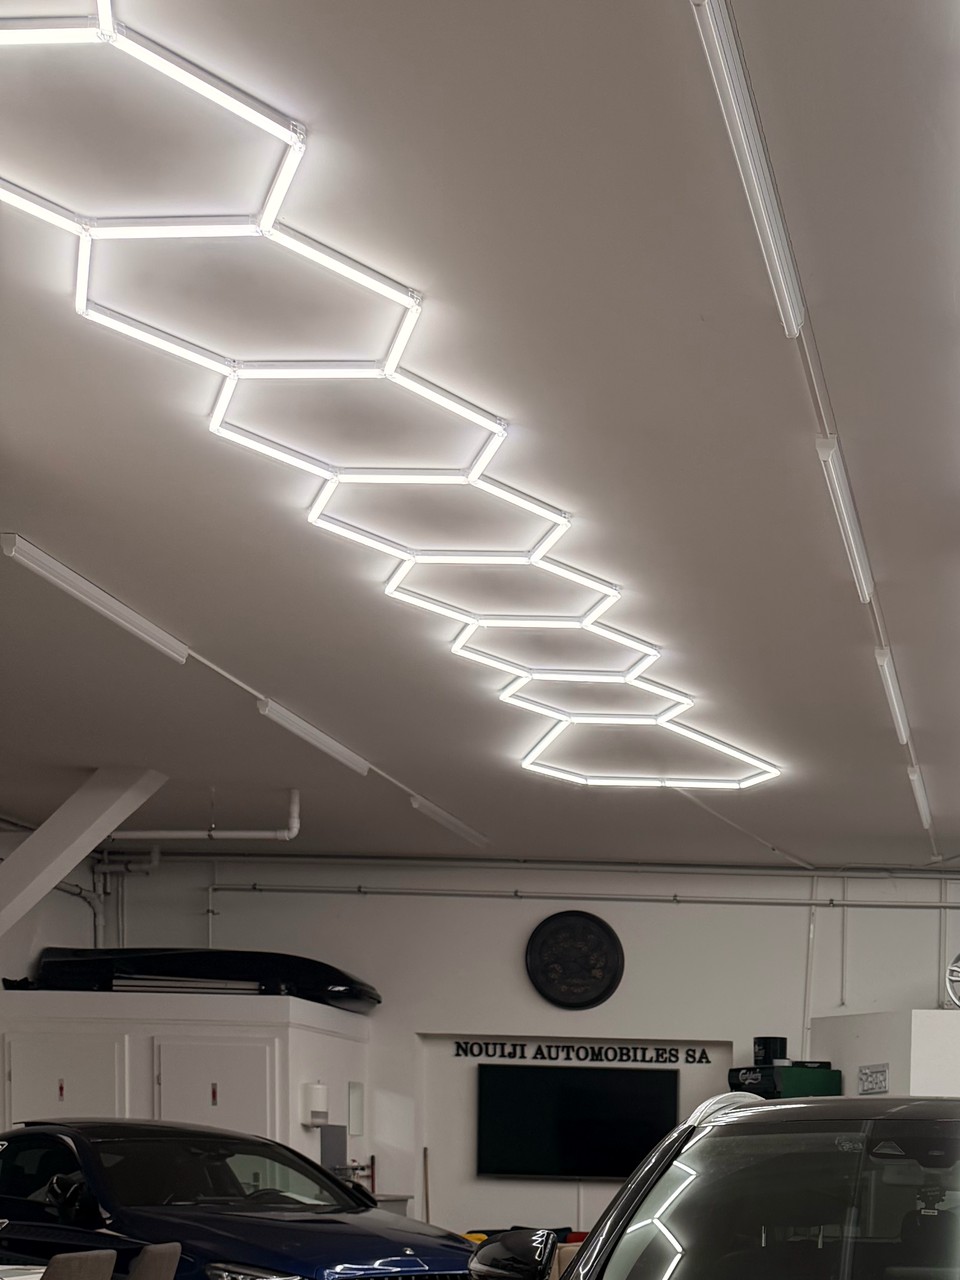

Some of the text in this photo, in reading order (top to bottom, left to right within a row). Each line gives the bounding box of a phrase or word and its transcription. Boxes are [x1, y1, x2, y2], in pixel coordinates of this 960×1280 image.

[454, 1041, 711, 1064] NOUIJI AUTOMOBILES SA
